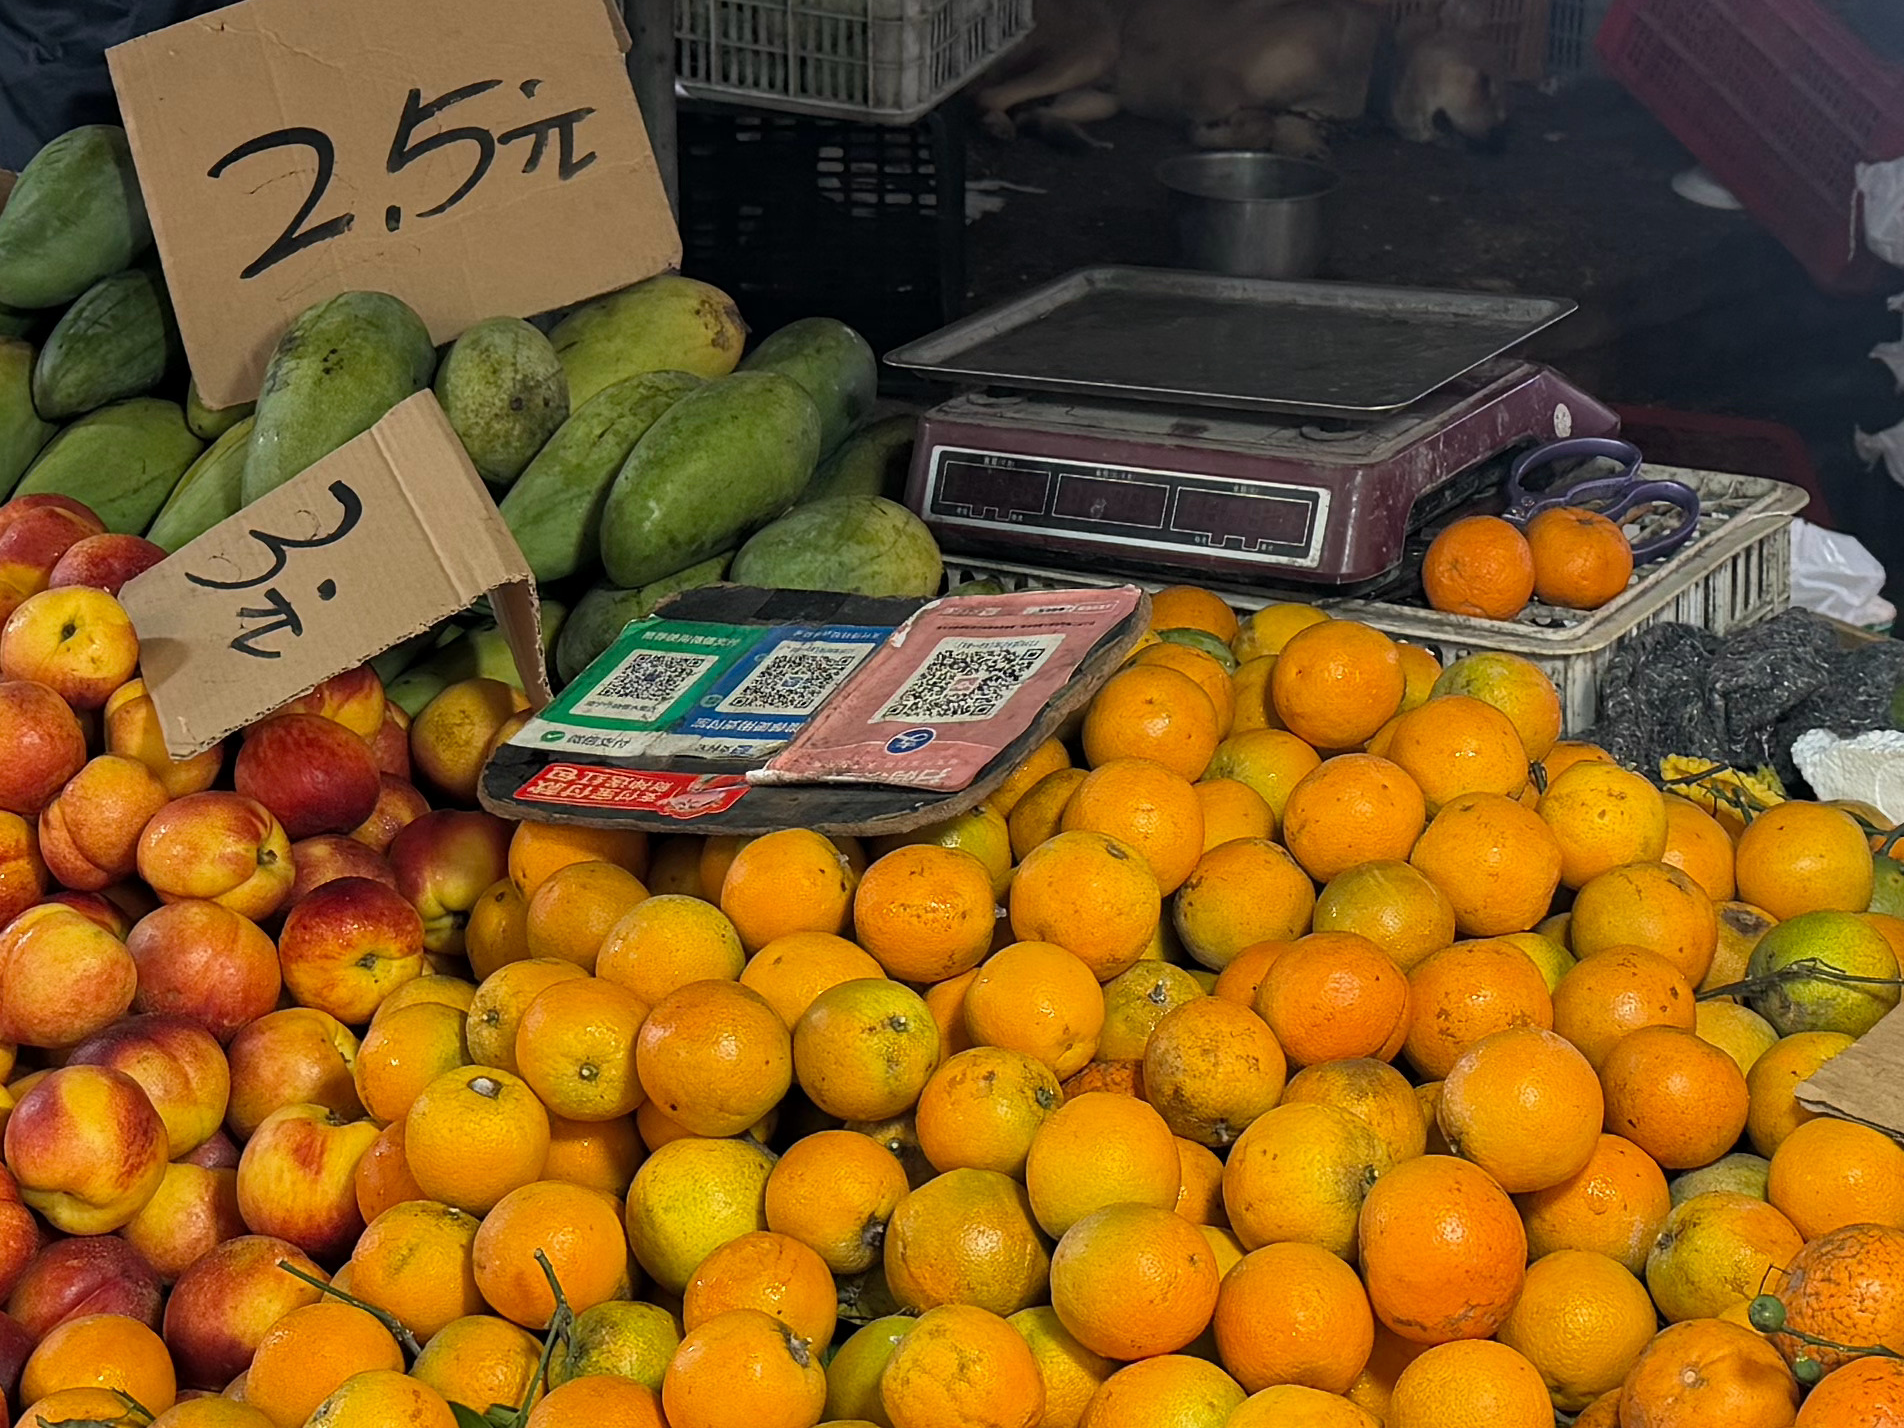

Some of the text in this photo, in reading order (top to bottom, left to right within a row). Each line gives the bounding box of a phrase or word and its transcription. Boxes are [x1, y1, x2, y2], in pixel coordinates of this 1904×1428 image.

[206, 77, 597, 281] 2.5元
[527, 778, 664, 804] 支付宝付款
